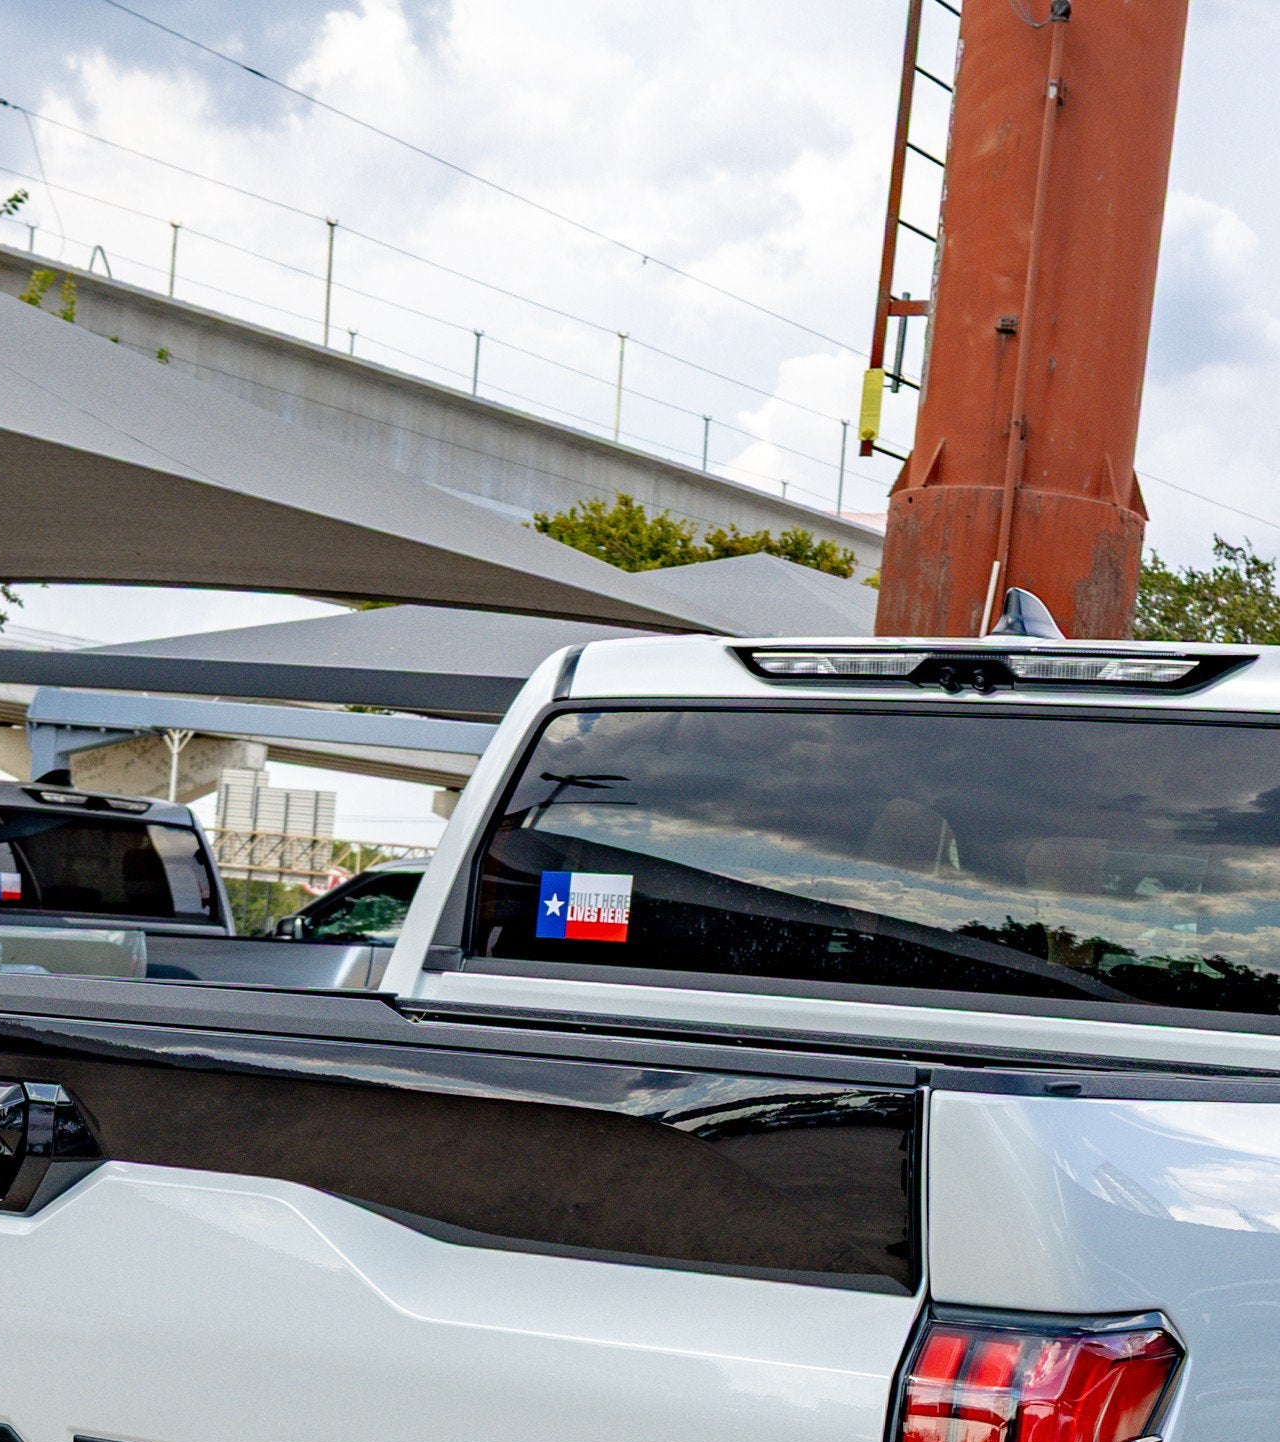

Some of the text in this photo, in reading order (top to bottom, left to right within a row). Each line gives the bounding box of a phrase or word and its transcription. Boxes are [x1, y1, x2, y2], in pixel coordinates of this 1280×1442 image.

[569, 892, 631, 910] BUILT HERE
[567, 906, 631, 925] LIVES HERE
